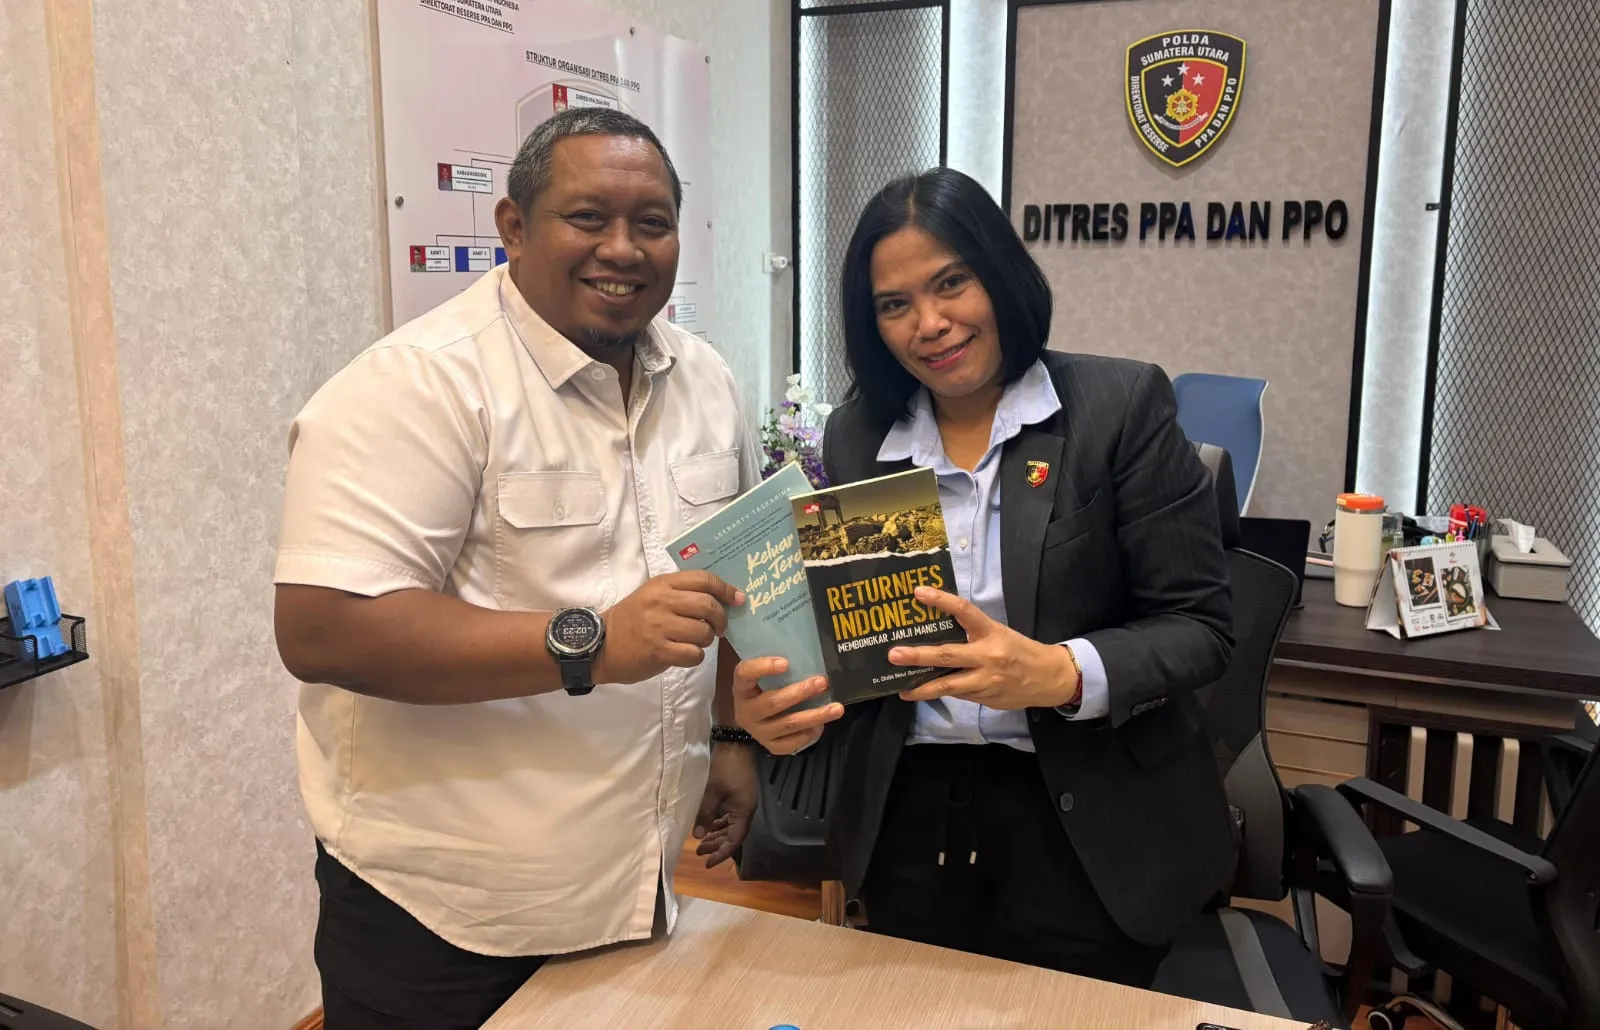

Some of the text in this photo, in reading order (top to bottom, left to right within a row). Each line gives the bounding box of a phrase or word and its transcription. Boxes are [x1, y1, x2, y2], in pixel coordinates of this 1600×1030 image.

[456, 7, 479, 21] RESERSE
[480, 14, 491, 24] PPA
[492, 17, 502, 27] DAN
[502, 21, 513, 31] PPO
[485, 4, 502, 17] UTARA
[1140, 46, 1230, 66] SUMATERA UTARA
[1162, 34, 1209, 47] POLDA
[525, 50, 557, 67] STRUKTUR
[557, 60, 591, 78] ORGANISASI
[591, 69, 609, 82] DITRES
[1131, 75, 1169, 152] DIREKTORAT RESERSE
[1194, 77, 1237, 148] PPA DAN PPO
[1022, 199, 1349, 242] DITRES PPA DAN PPO
[745, 548, 802, 592] dari Jera
[747, 533, 794, 574] Keluar
[749, 566, 807, 615] Kekeras
[826, 564, 944, 612] RETURNEES
[837, 619, 954, 654] MEMBONGKAR JANJI MANIS ISIS
